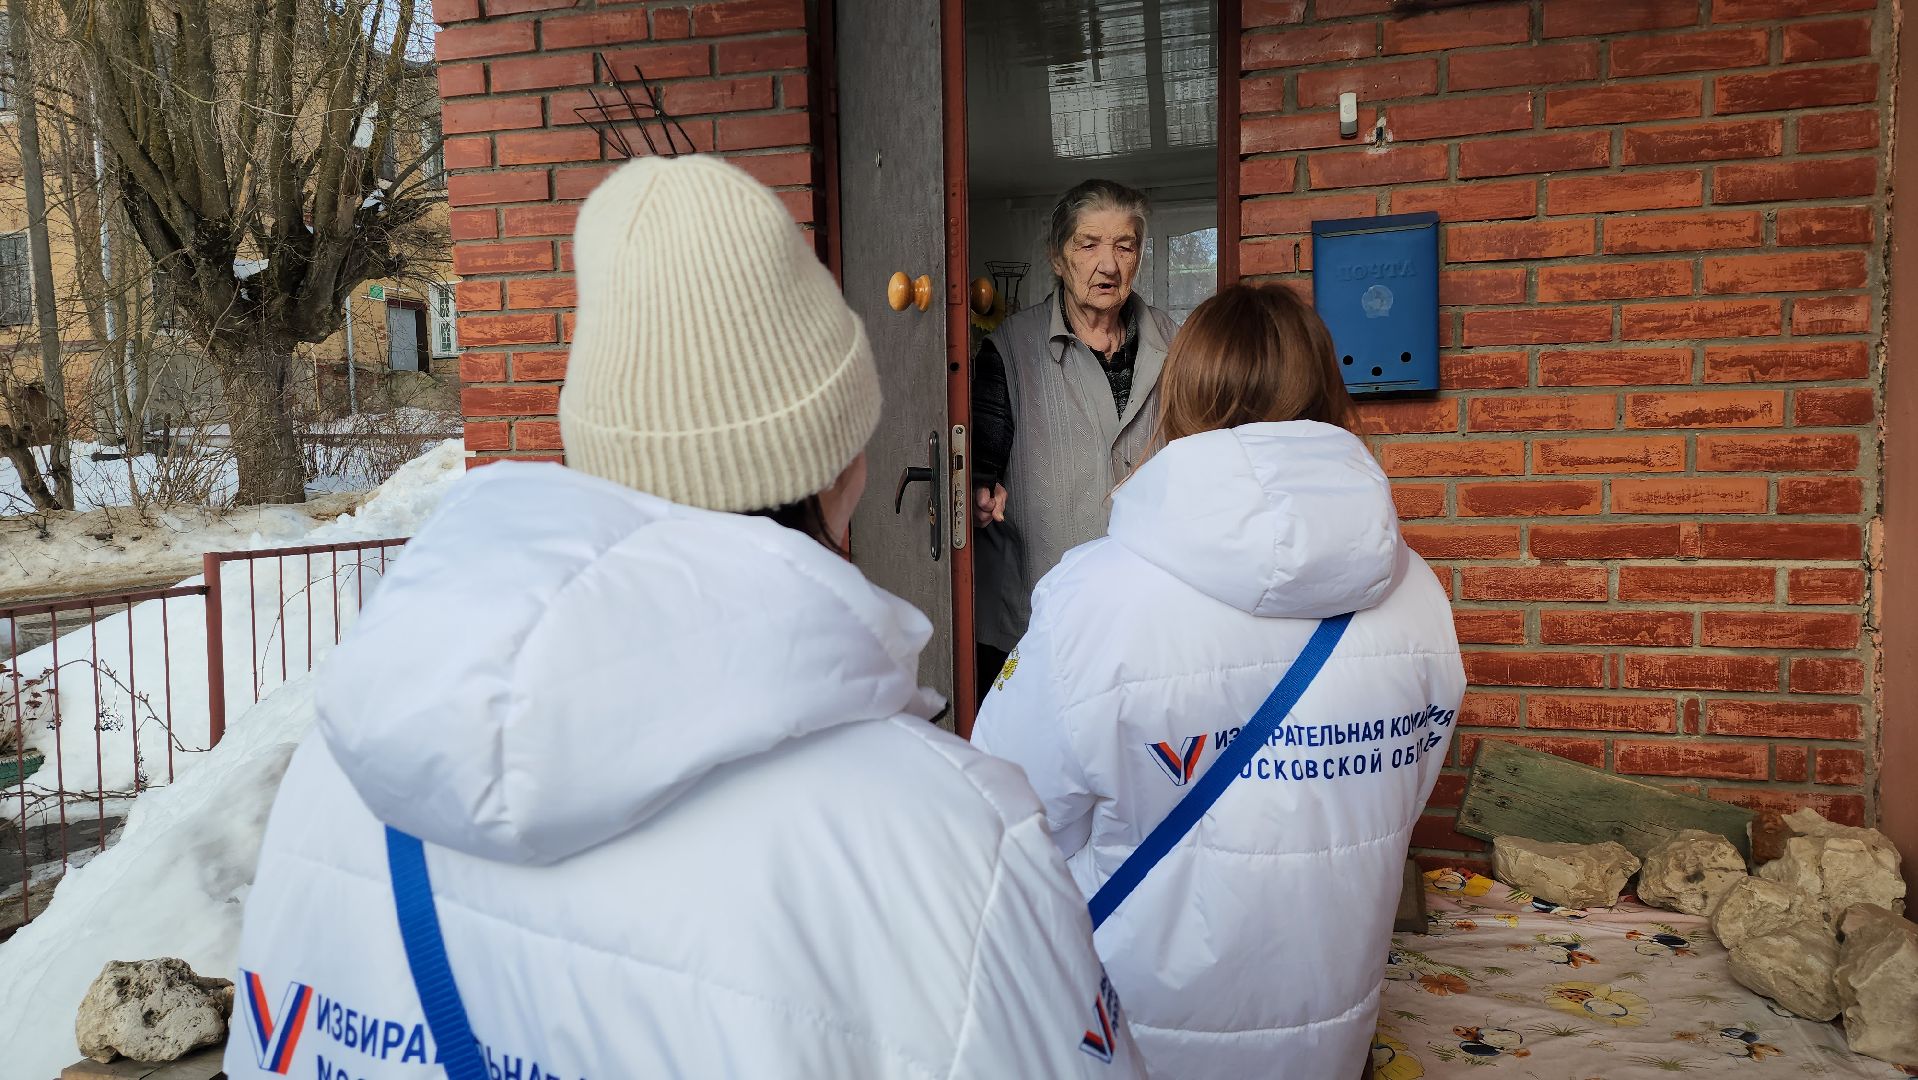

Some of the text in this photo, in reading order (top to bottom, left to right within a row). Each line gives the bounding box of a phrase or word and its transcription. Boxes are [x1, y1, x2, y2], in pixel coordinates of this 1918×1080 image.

[1337, 259, 1417, 281] ПОЧТА
[1215, 719, 1384, 750] ИЗРАТЕЛЬНАЯ
[1240, 749, 1382, 780] ОСКОВСКОЙ
